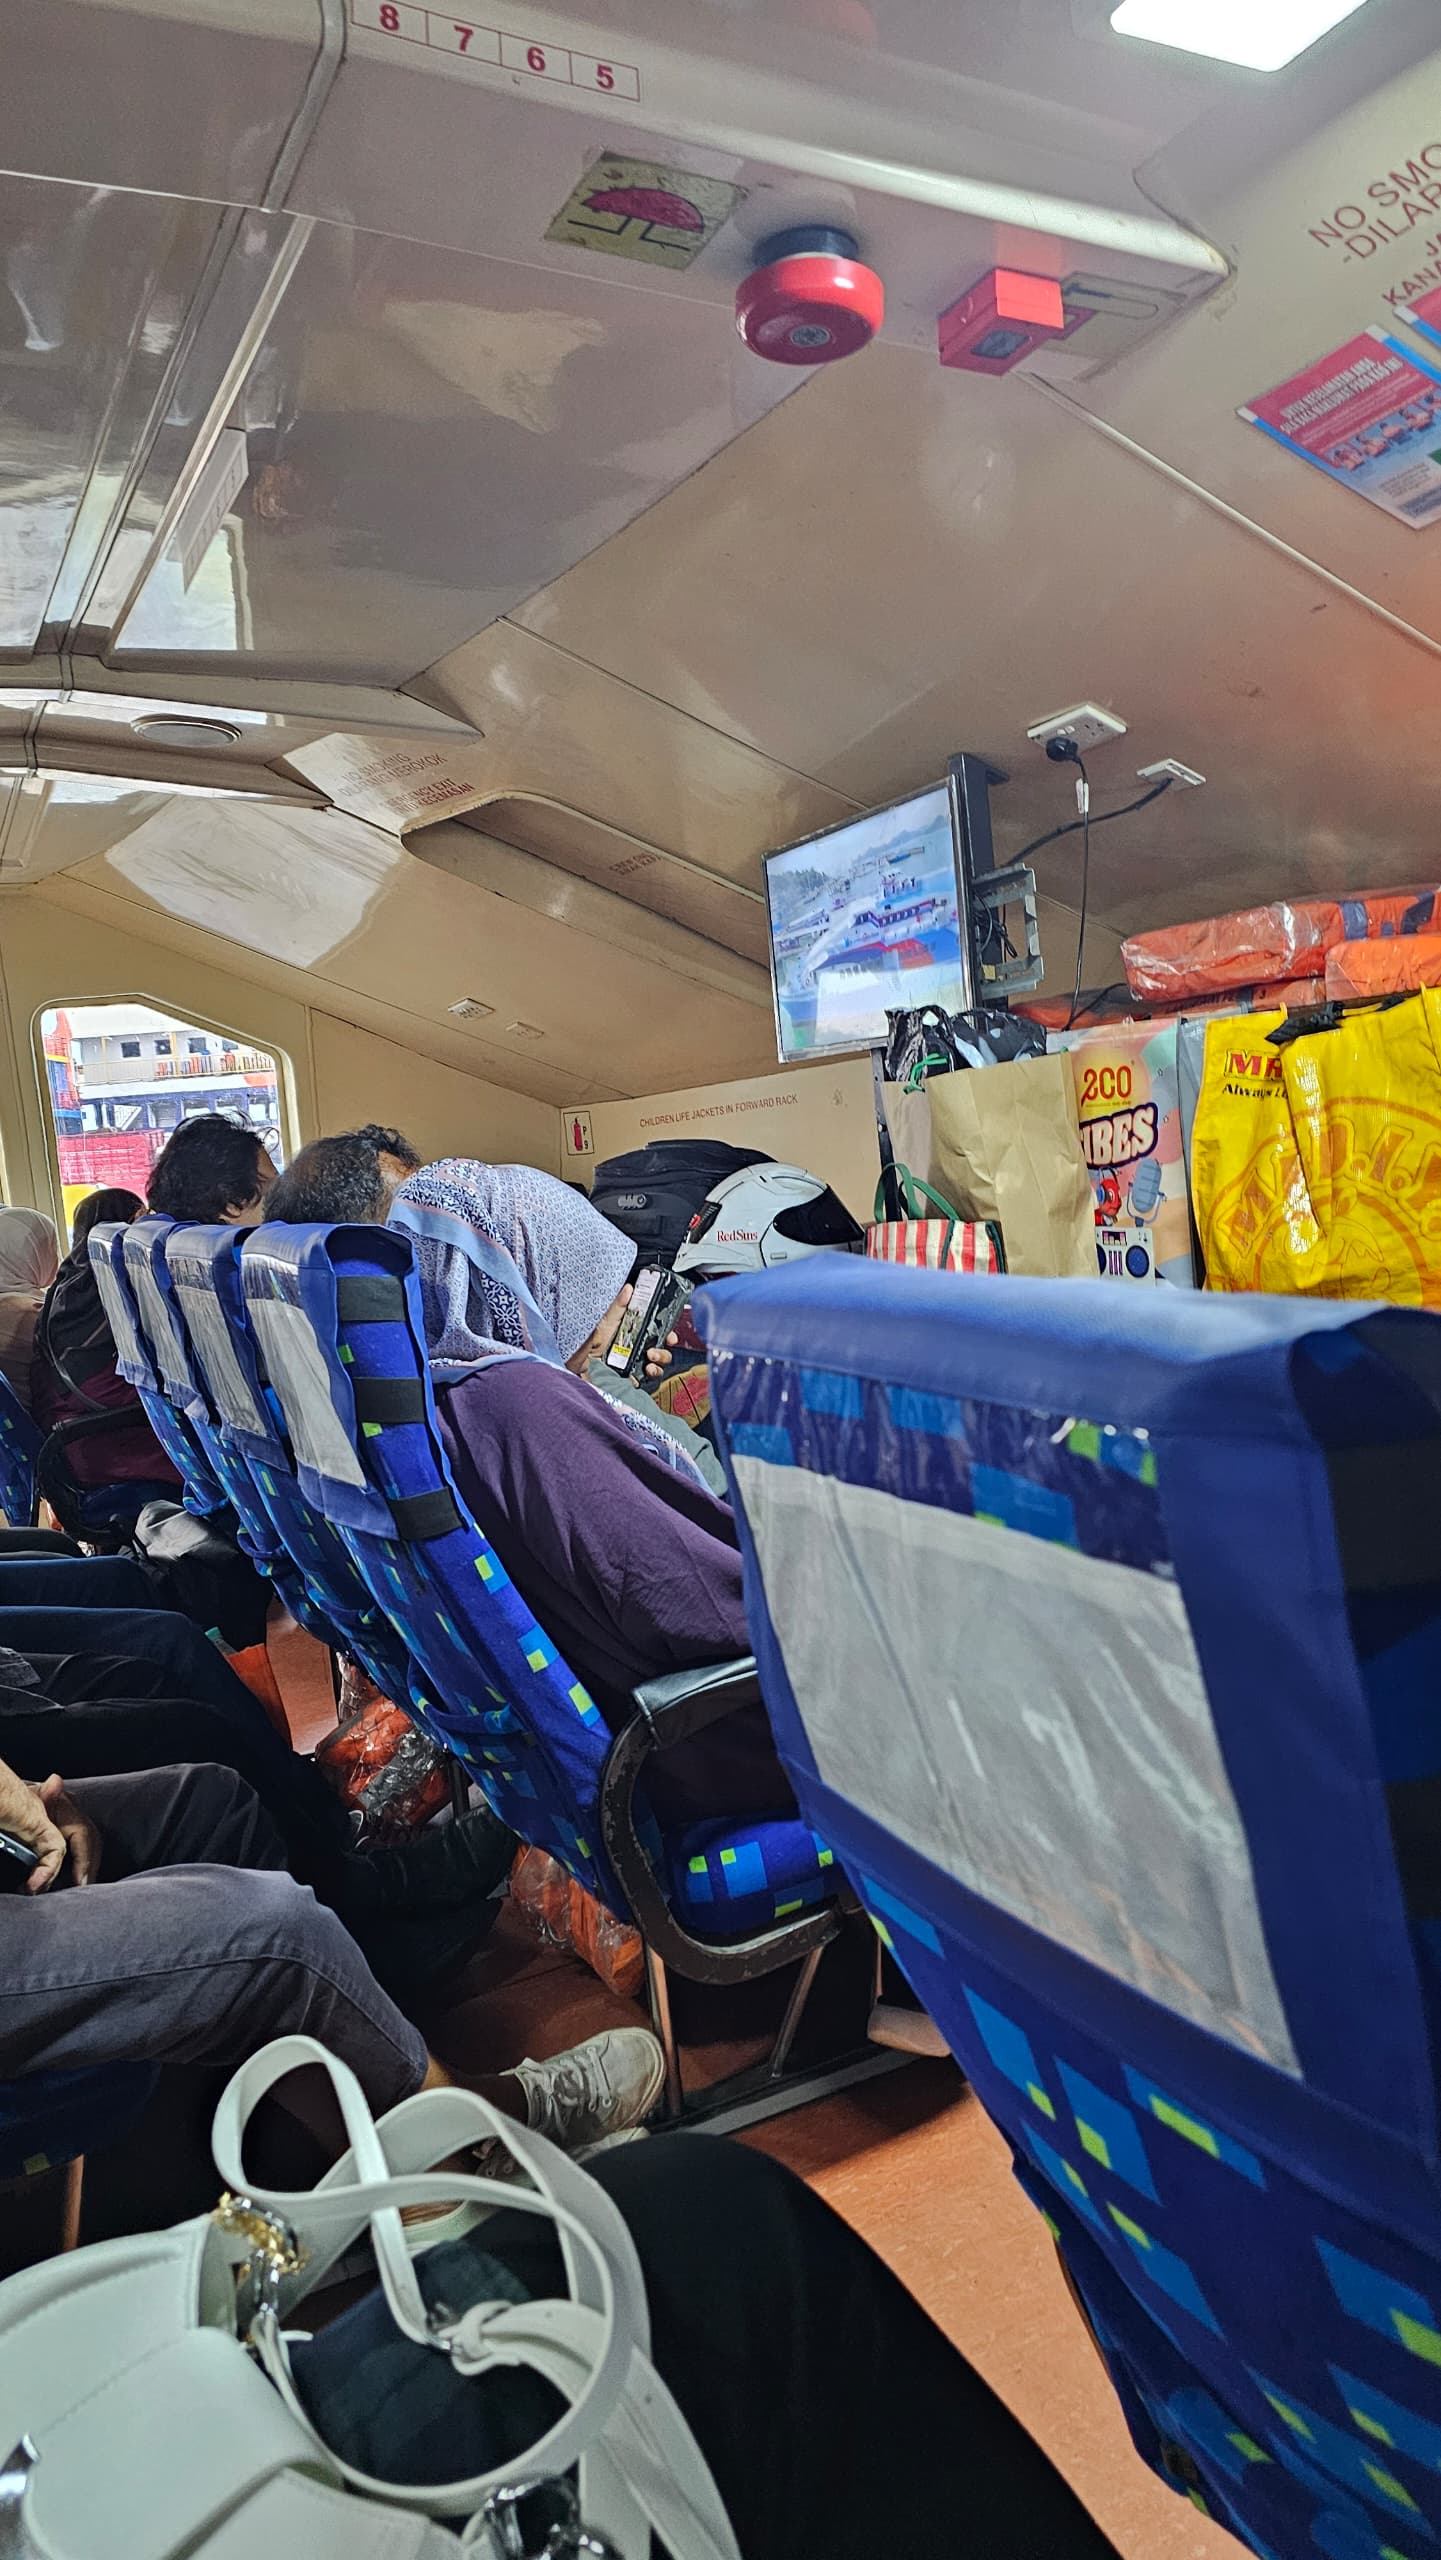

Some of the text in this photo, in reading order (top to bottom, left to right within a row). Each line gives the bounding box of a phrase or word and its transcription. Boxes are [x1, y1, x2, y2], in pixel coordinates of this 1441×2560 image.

[379, 4, 615, 90] 8 7 6 5
[1308, 205, 1366, 248] NO
[639, 1094, 799, 1128] CHILDREN LIFE JACKETS IN FORWARD RACK
[1079, 1105, 1157, 1168] IBES
